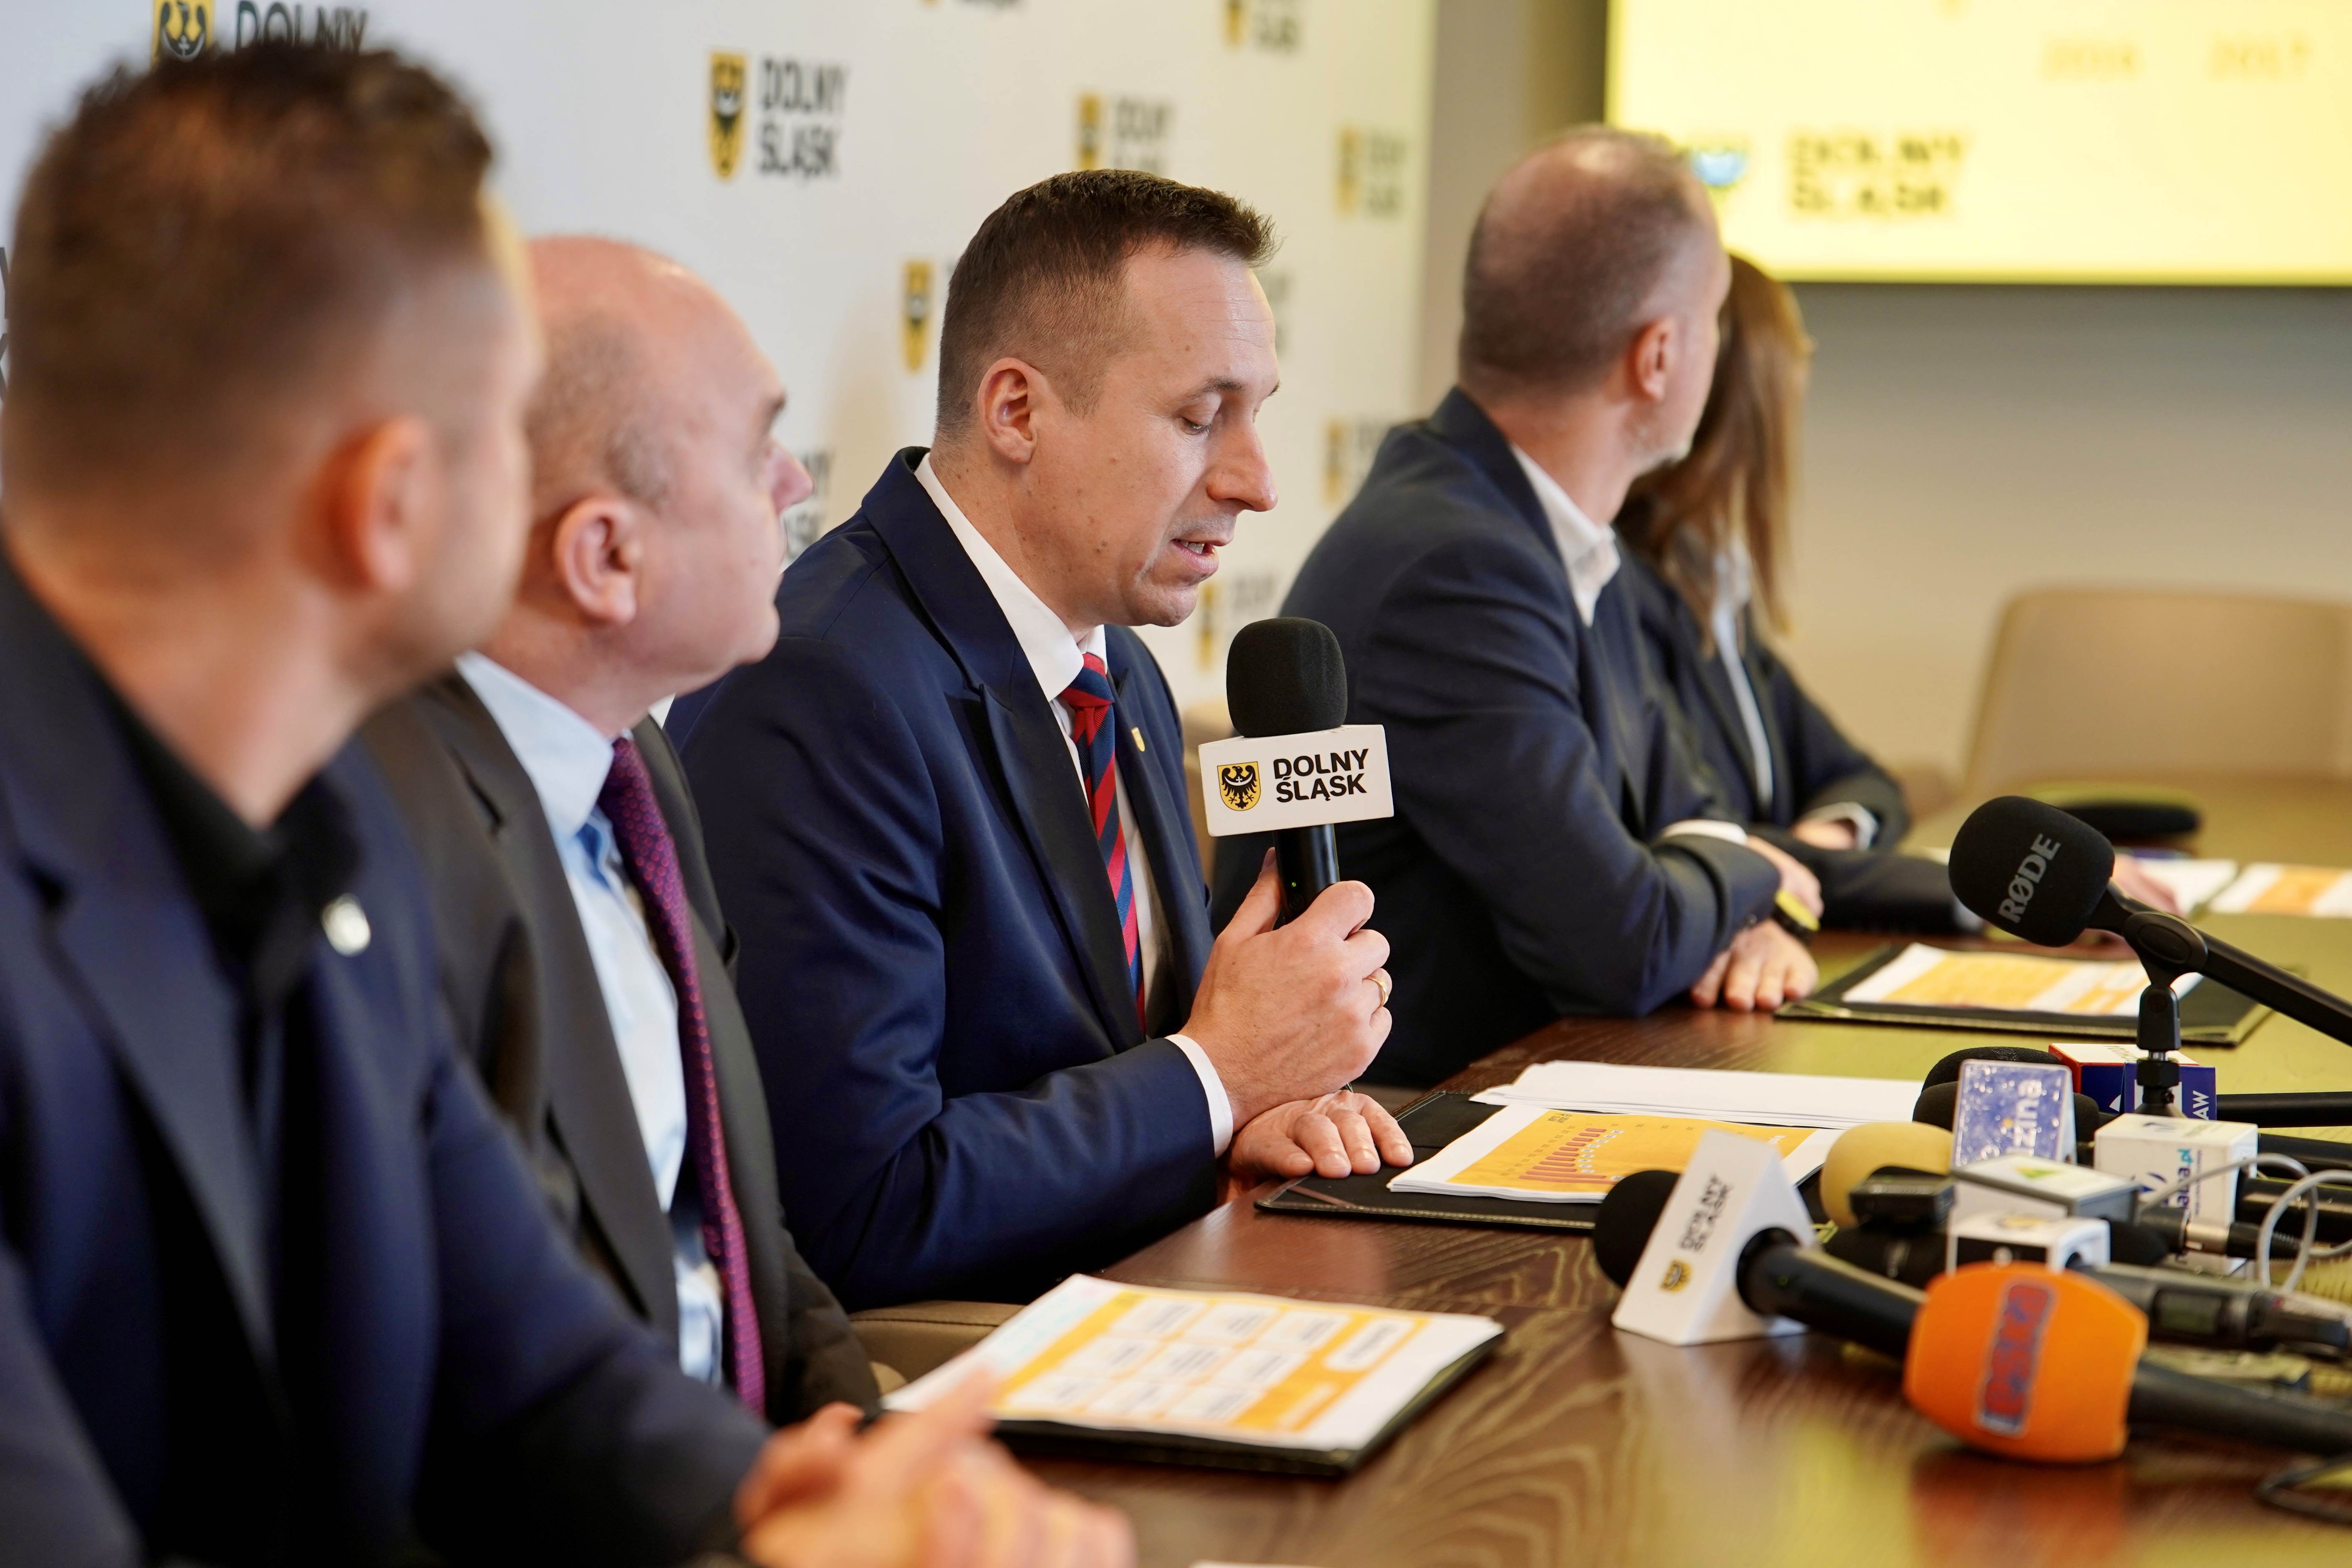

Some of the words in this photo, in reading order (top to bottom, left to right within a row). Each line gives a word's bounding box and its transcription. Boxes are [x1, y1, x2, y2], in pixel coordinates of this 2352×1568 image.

[760, 56, 850, 113] DOLNY
[1273, 748, 1369, 779] DOLNY
[1276, 773, 1367, 803] ŚLĄSK
[1998, 834, 2062, 923] RØDE
